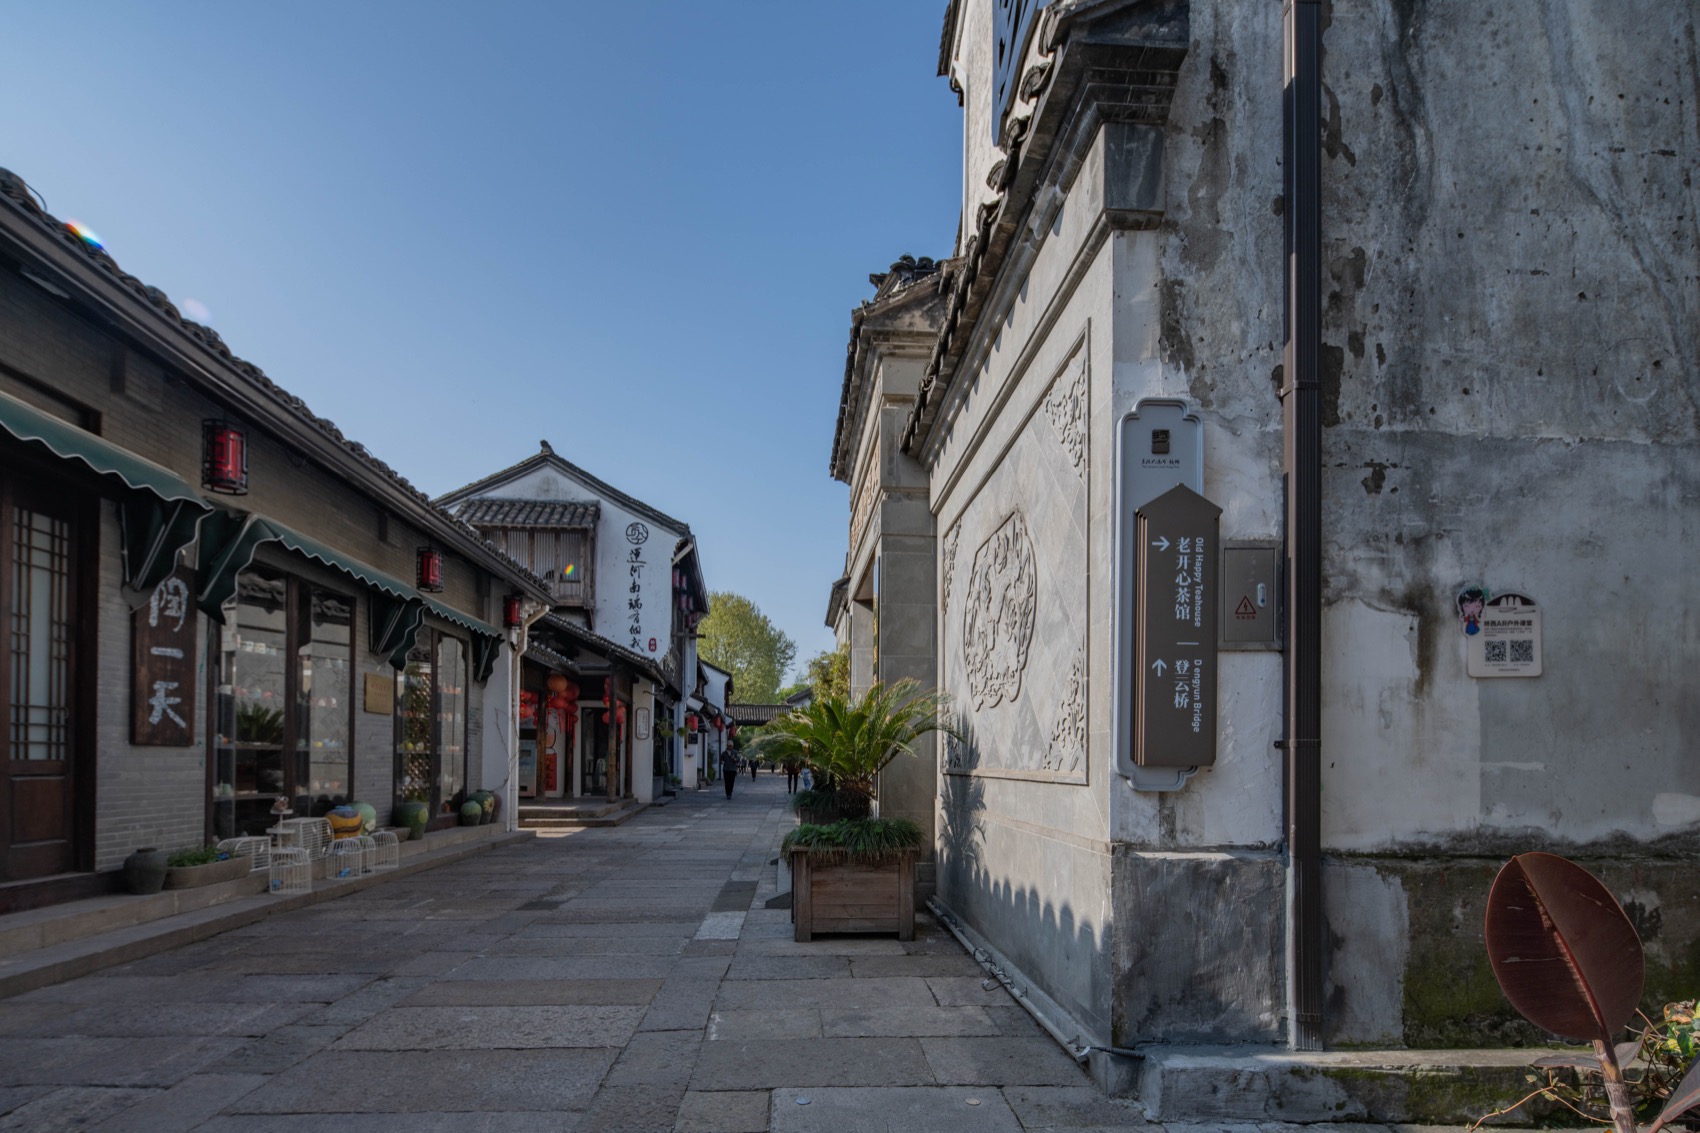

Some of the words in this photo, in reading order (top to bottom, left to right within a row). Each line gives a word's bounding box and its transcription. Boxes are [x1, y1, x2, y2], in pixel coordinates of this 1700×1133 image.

[1195, 537, 1204, 553] Old
[1175, 537, 1191, 620] 老开心茶馆
[1194, 555, 1204, 583] Happy
[1194, 584, 1204, 627] Teahouse
[149, 577, 188, 728] 陶一天
[1174, 659, 1190, 709] 登云桥
[1192, 702, 1202, 733] Bridge
